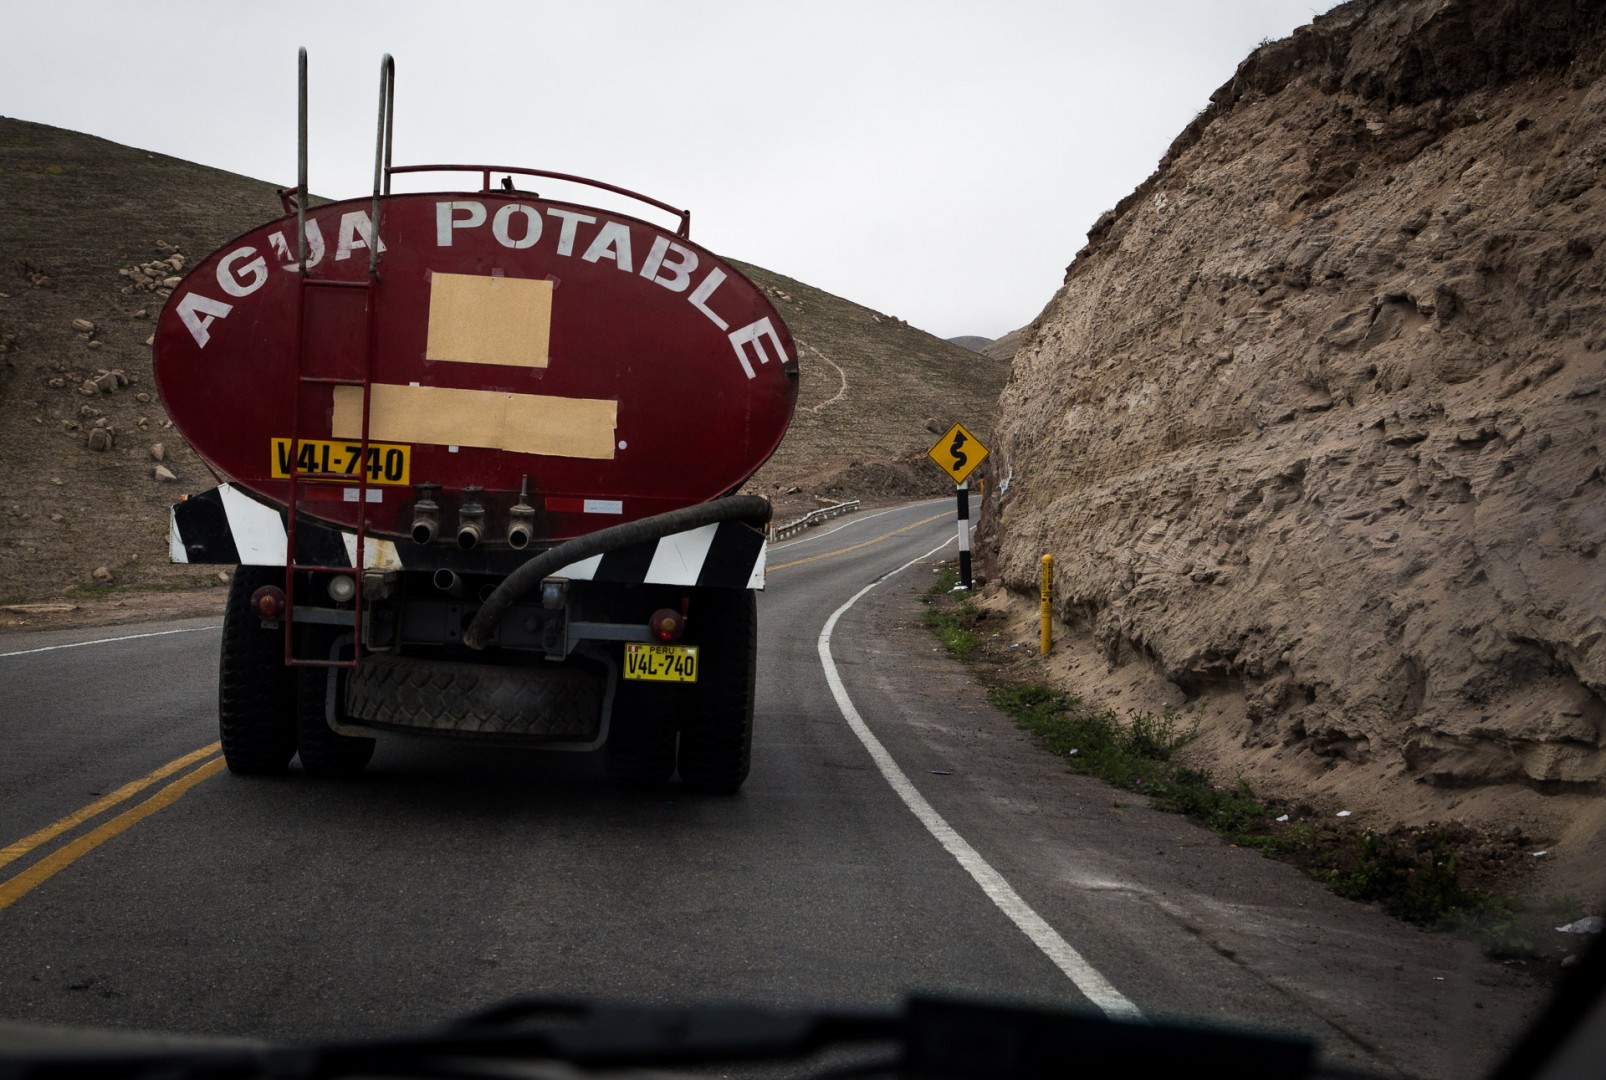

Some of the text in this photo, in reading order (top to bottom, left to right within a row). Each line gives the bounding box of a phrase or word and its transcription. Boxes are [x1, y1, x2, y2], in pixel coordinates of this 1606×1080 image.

[175, 200, 789, 380] AGUA POTABLE
[277, 441, 404, 482] V4L-740
[628, 653, 695, 677] V4L-740
[649, 646, 675, 655] PERU
